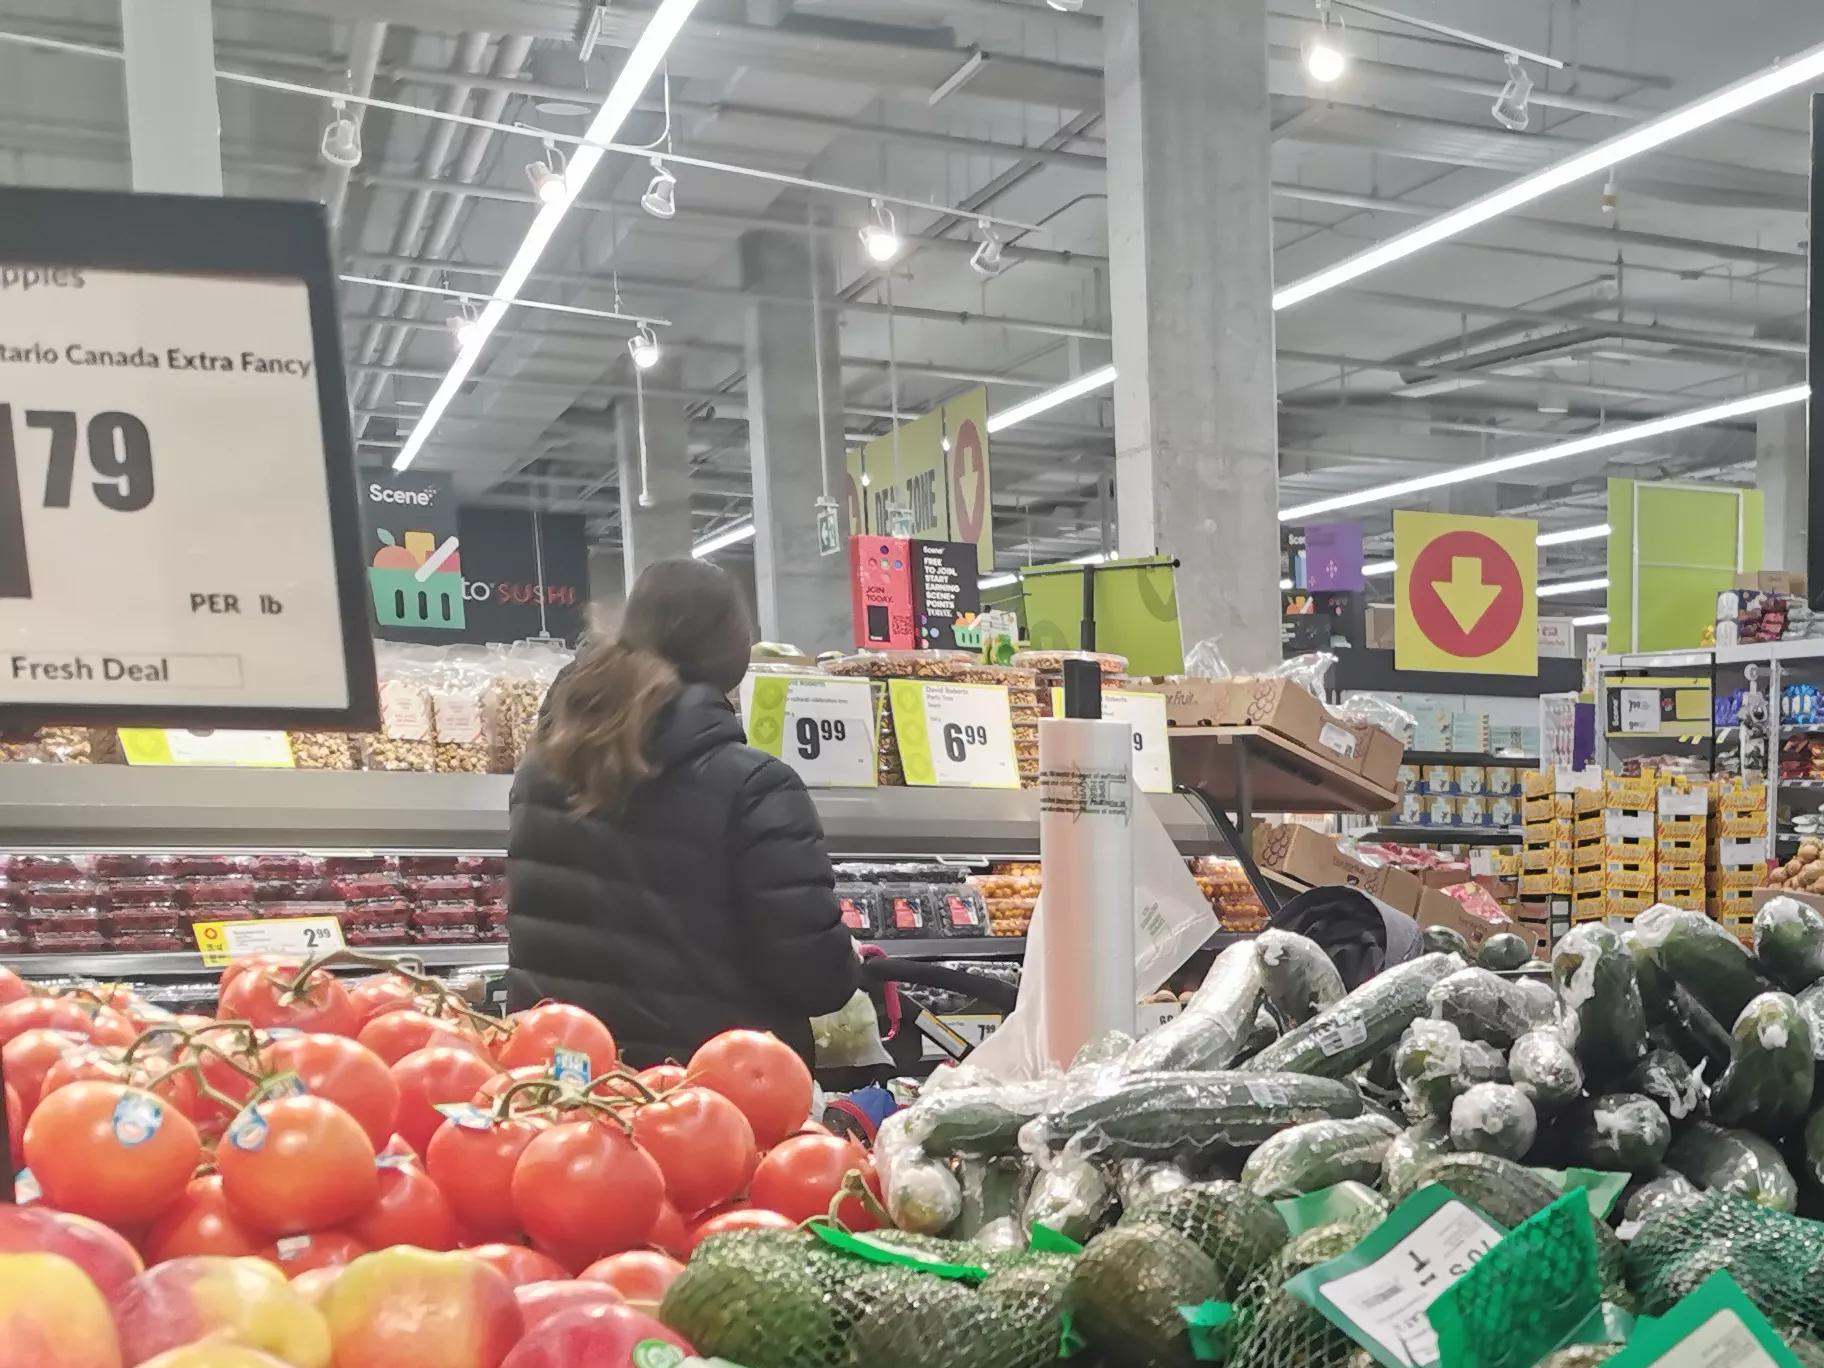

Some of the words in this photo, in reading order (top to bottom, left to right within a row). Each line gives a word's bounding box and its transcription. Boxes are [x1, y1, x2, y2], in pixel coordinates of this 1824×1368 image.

[66, 343, 160, 370] Canada
[168, 348, 234, 372] Extra
[241, 351, 311, 378] Fancy
[906, 468, 937, 535] ZONE
[497, 582, 577, 606] SUSHI
[866, 586, 885, 594] JOIN
[190, 592, 242, 615] PER
[259, 593, 283, 615] lb
[11, 655, 94, 681] Fresh
[102, 657, 170, 682] Deal
